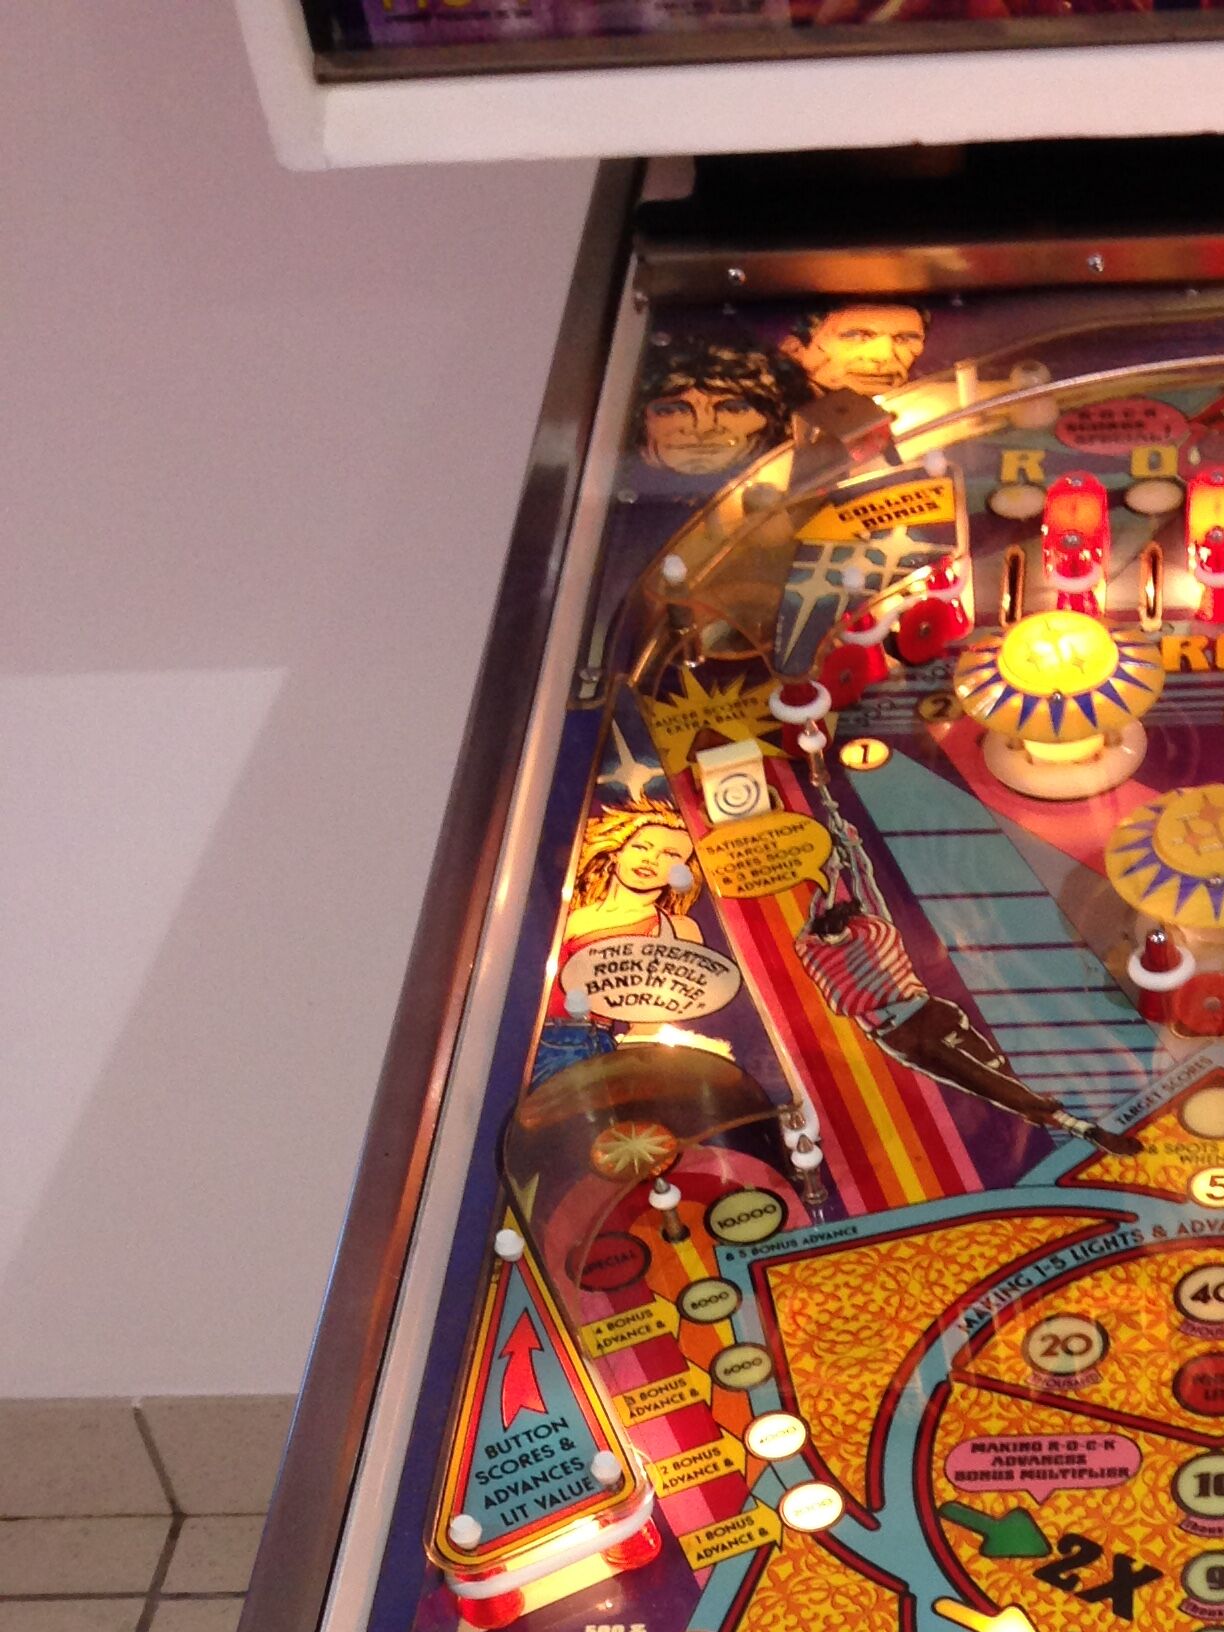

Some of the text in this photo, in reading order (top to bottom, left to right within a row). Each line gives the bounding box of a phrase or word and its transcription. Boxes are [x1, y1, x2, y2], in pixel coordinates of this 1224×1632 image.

[1002, 450, 1046, 483] R
[1130, 445, 1178, 478] O
[594, 960, 643, 974] ROCK
[663, 962, 707, 985] ROLL
[642, 944, 729, 976] GREATEST
[585, 974, 705, 1000] BAND IN THE
[958, 1276, 1032, 1334] MAKING
[1035, 1256, 1067, 1278] 1-5
[1071, 1228, 1145, 1262] LIGHTS
[1152, 1225, 1168, 1238] &
[1040, 1332, 1092, 1357] 20
[484, 1417, 569, 1459] BUTTON
[475, 1437, 576, 1485] SCORES &
[484, 1457, 585, 1510] ADVANCES
[500, 1477, 595, 1526] LIT VALUE
